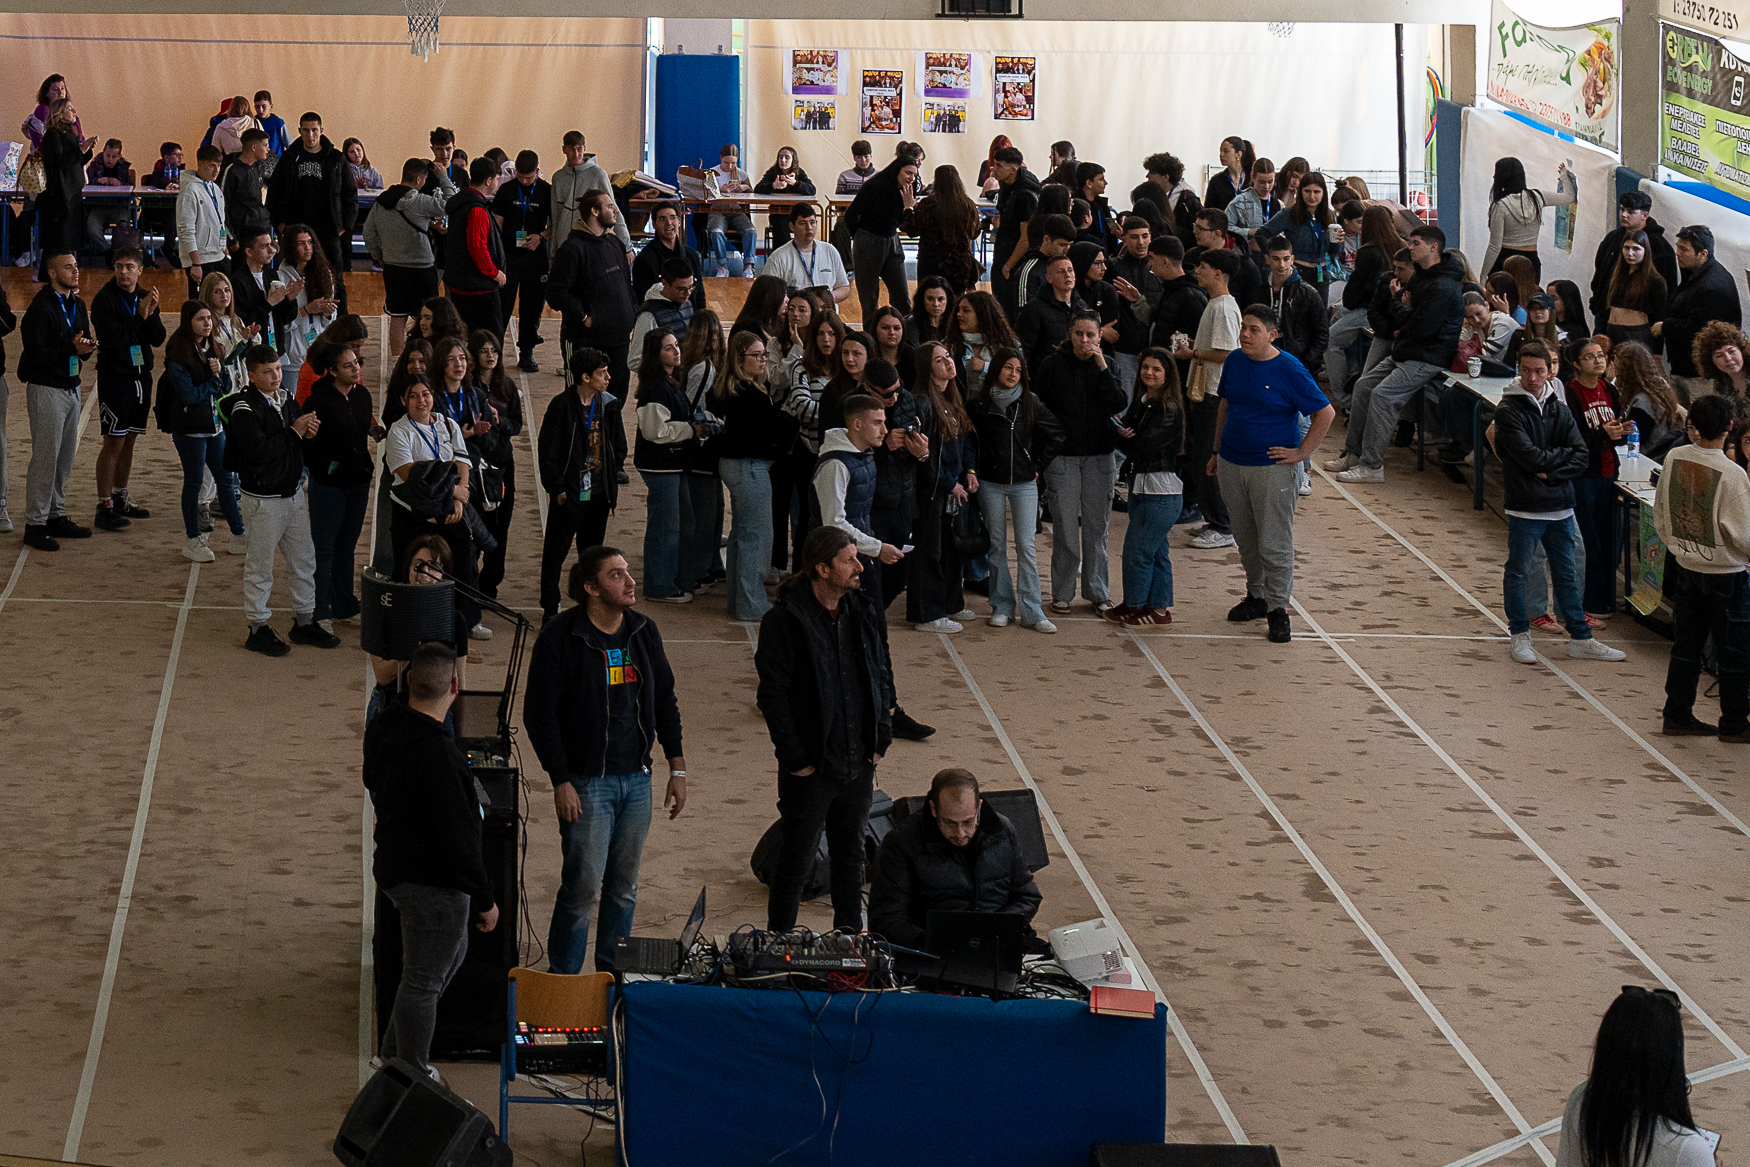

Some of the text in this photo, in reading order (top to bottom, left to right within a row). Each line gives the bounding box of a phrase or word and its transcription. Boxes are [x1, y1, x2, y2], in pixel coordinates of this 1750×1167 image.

[1708, 7, 1720, 26] 72
[1722, 11, 1739, 30] 251
[1670, 136, 1700, 158] ΒΛΑΒΕΣ
